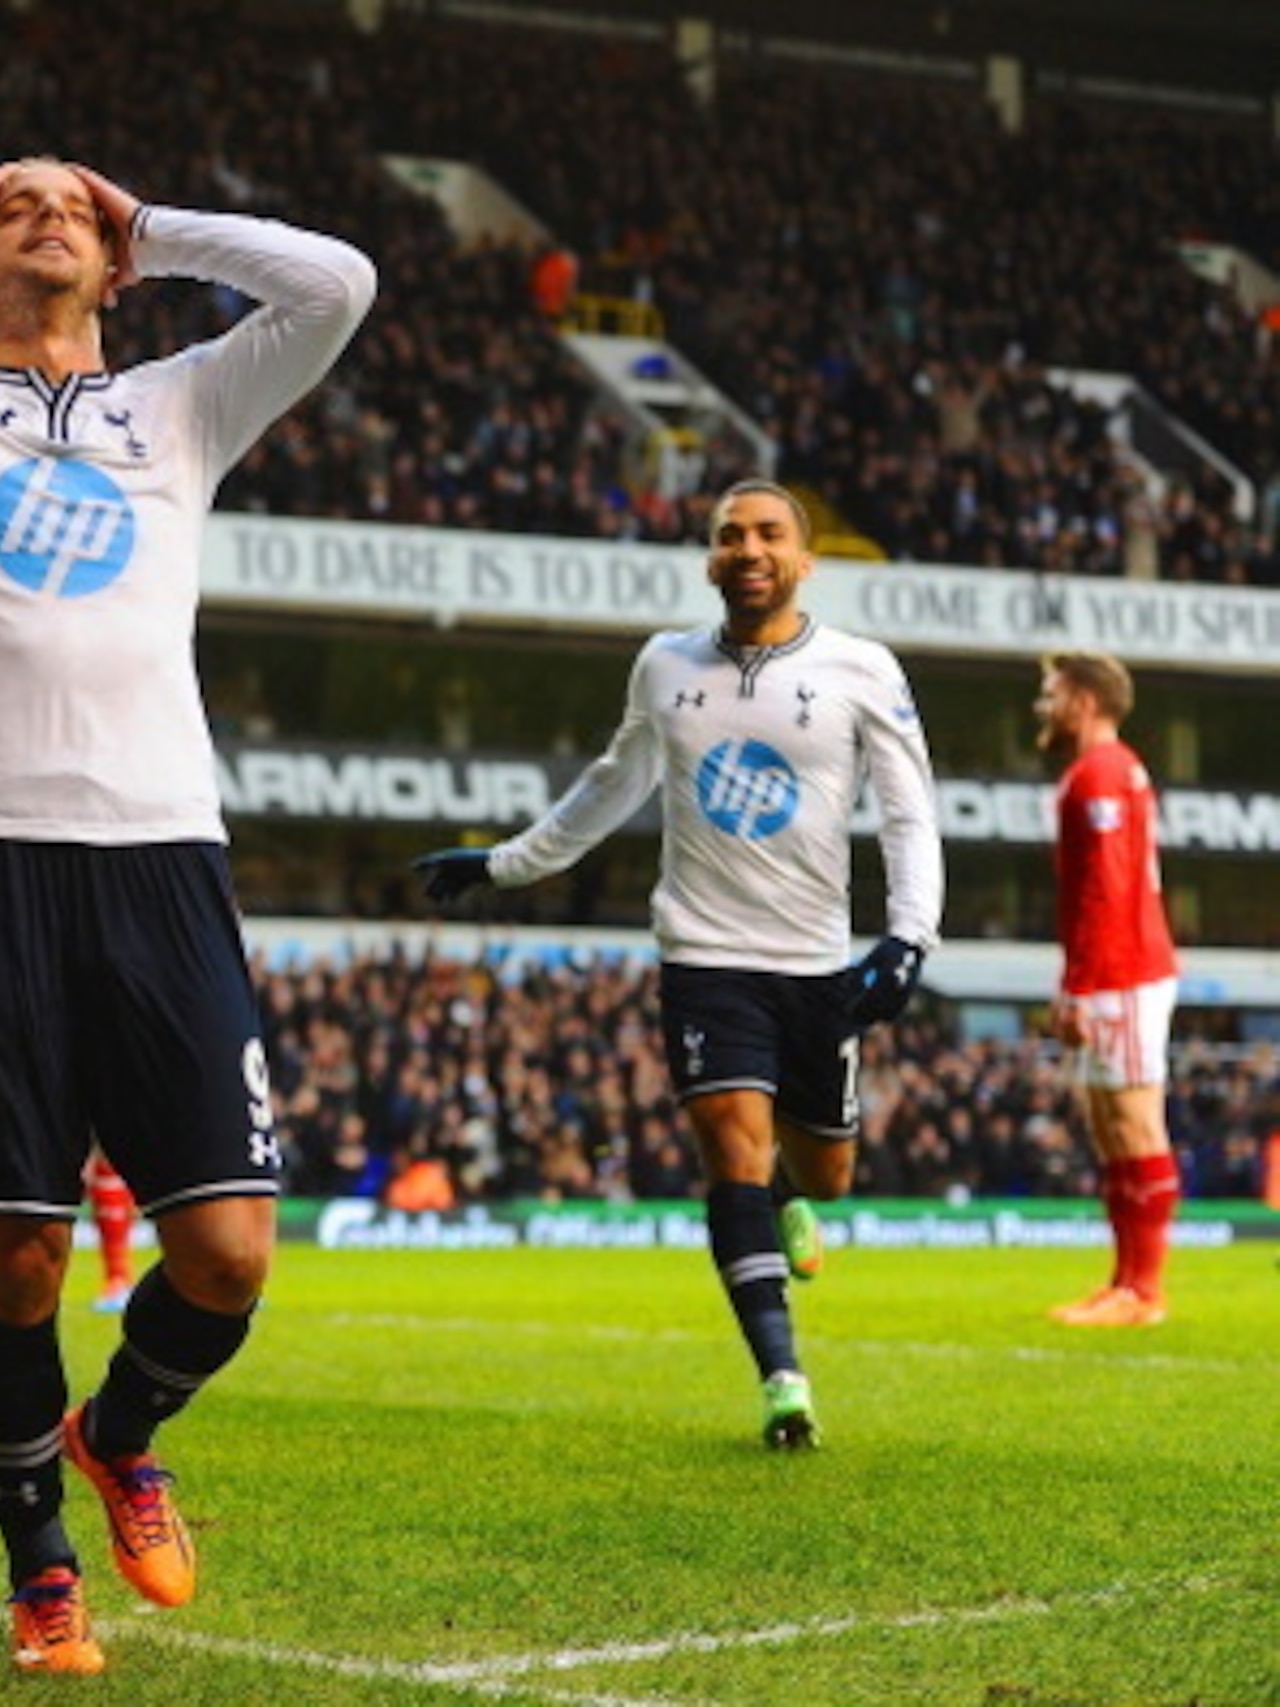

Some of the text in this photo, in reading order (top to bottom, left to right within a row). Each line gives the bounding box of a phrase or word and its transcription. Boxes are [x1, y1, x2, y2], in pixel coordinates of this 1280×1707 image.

[231, 529, 684, 610] TO DARE IS TO DO
[859, 578, 982, 634] COME
[1084, 594, 1175, 645] YOU
[702, 737, 798, 840] hp
[242, 1036, 274, 1130] 9
